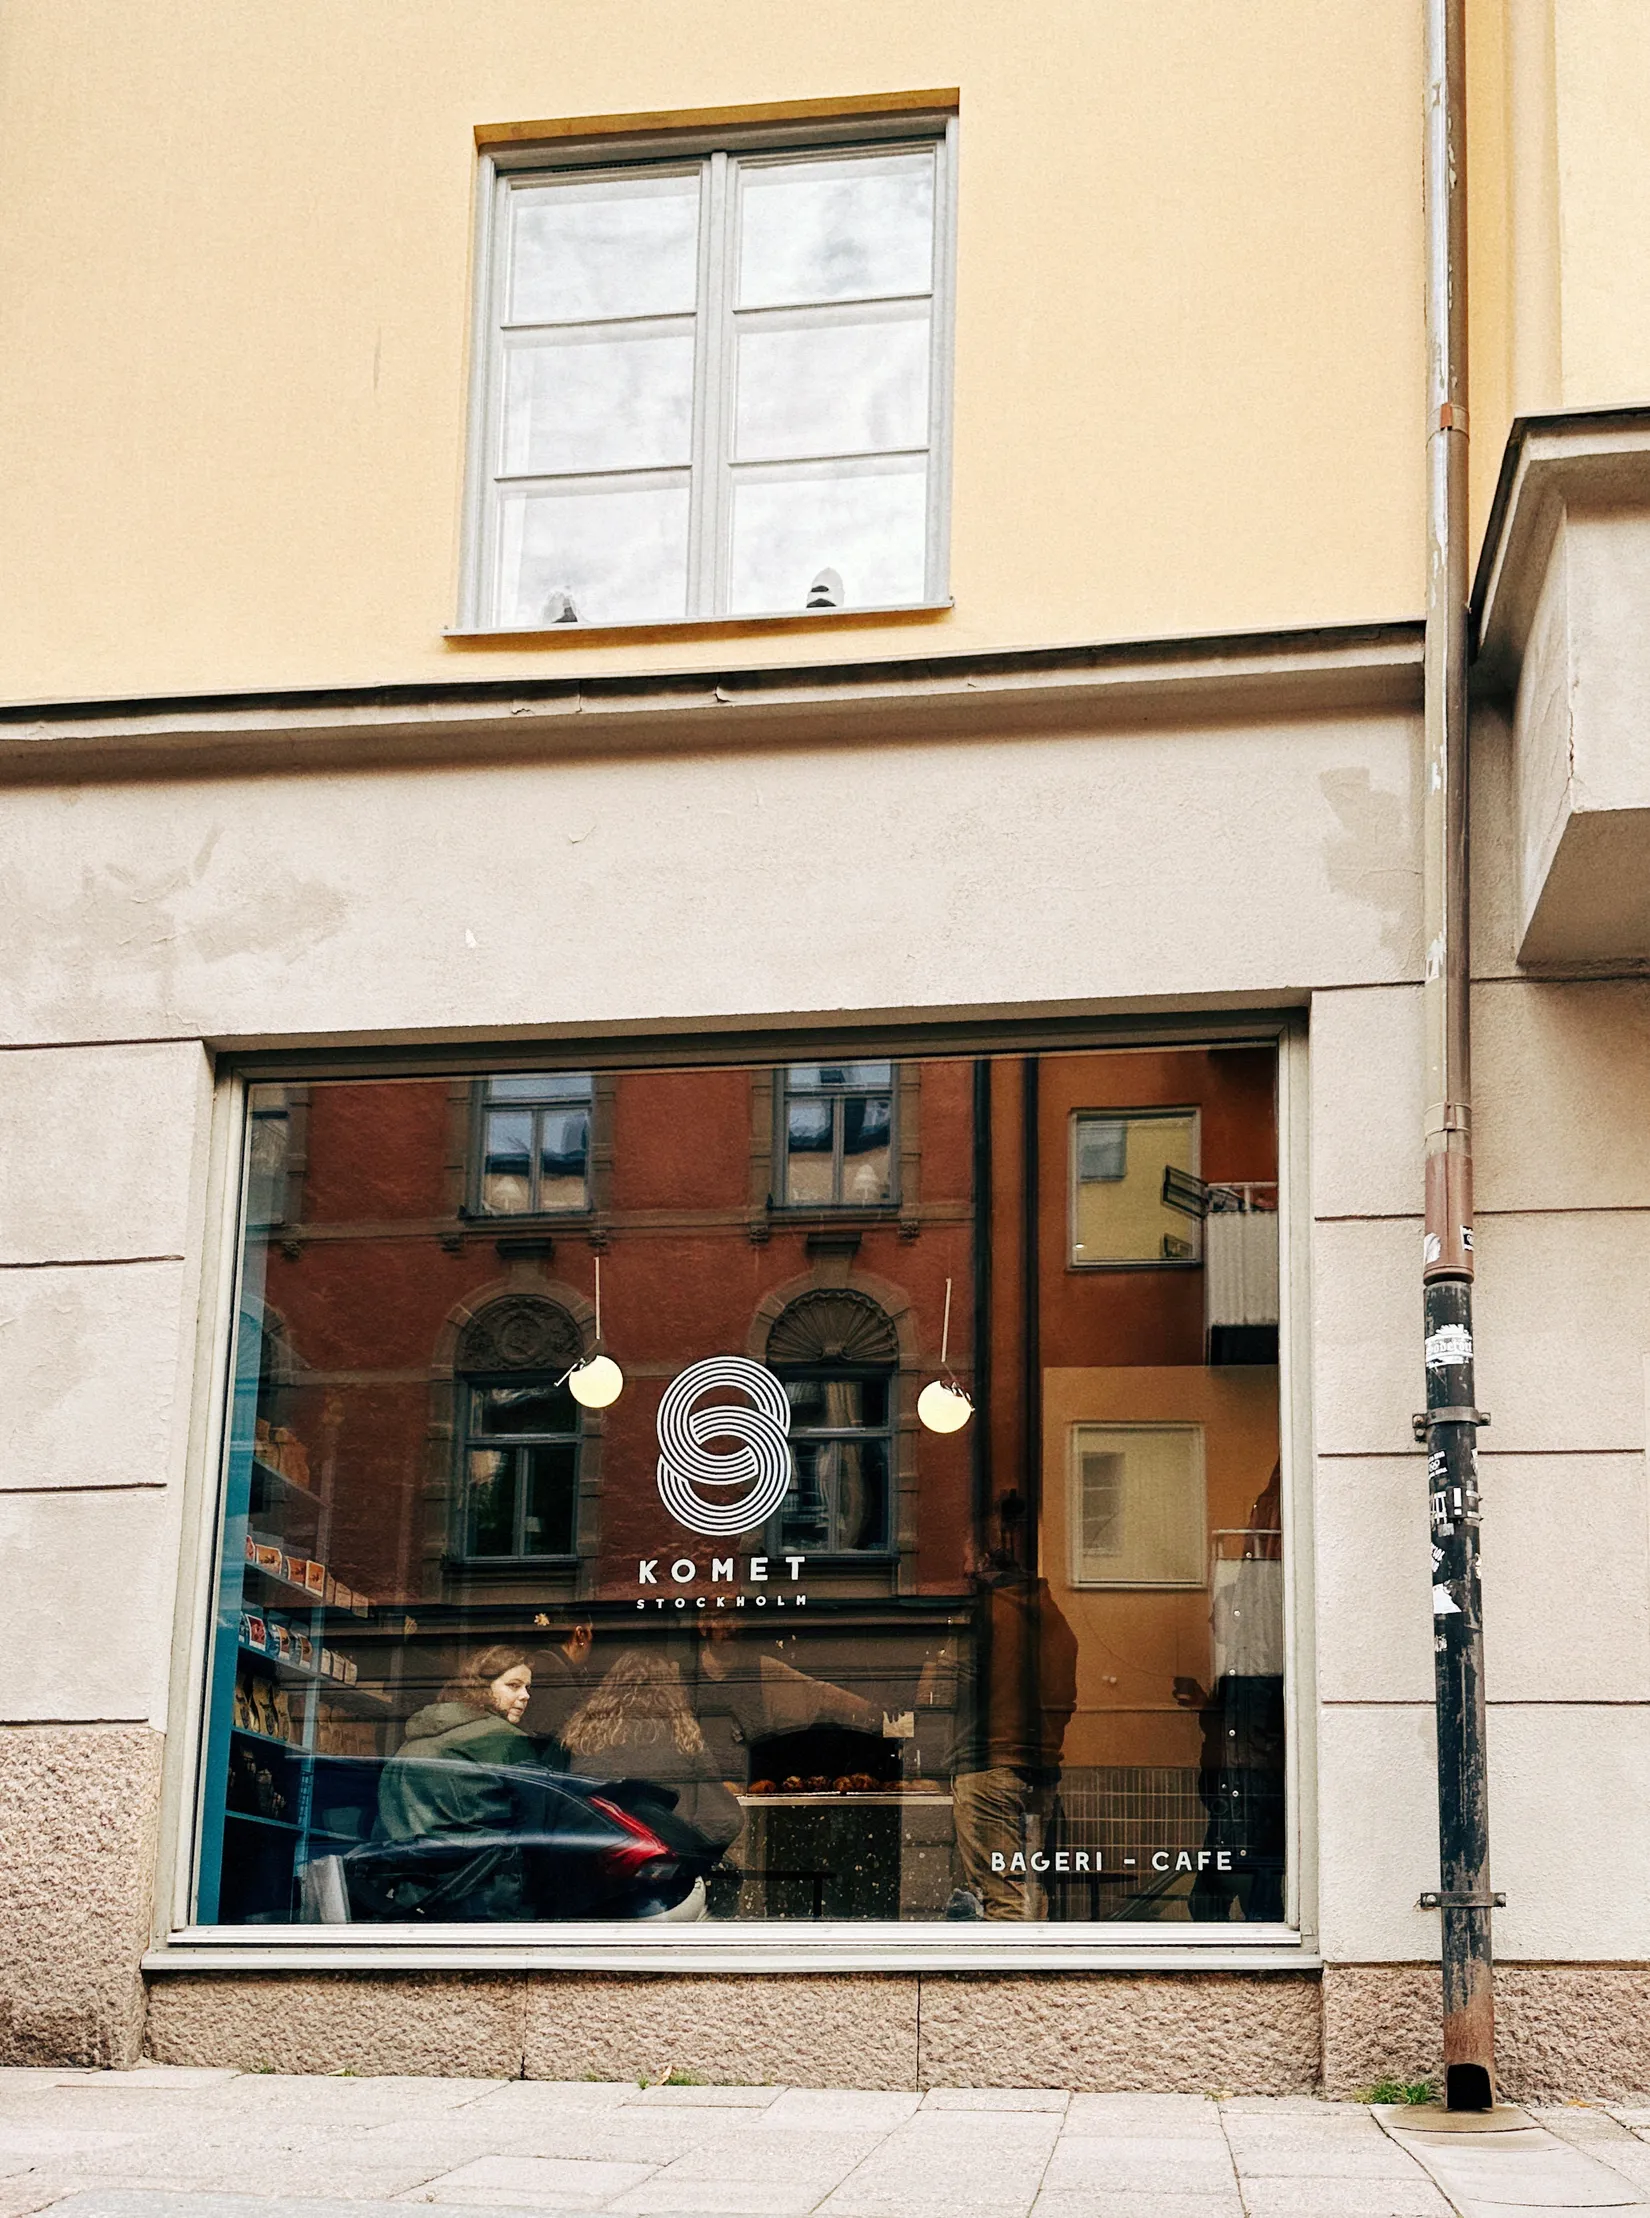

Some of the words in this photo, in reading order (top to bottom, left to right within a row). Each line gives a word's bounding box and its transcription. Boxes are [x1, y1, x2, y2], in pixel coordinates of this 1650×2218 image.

[638, 1556, 806, 1584] KOMET
[636, 1595, 806, 1609] STOCKHOLM
[991, 1851, 1102, 1872] BAGERI
[1151, 1851, 1232, 1871] CAFE
